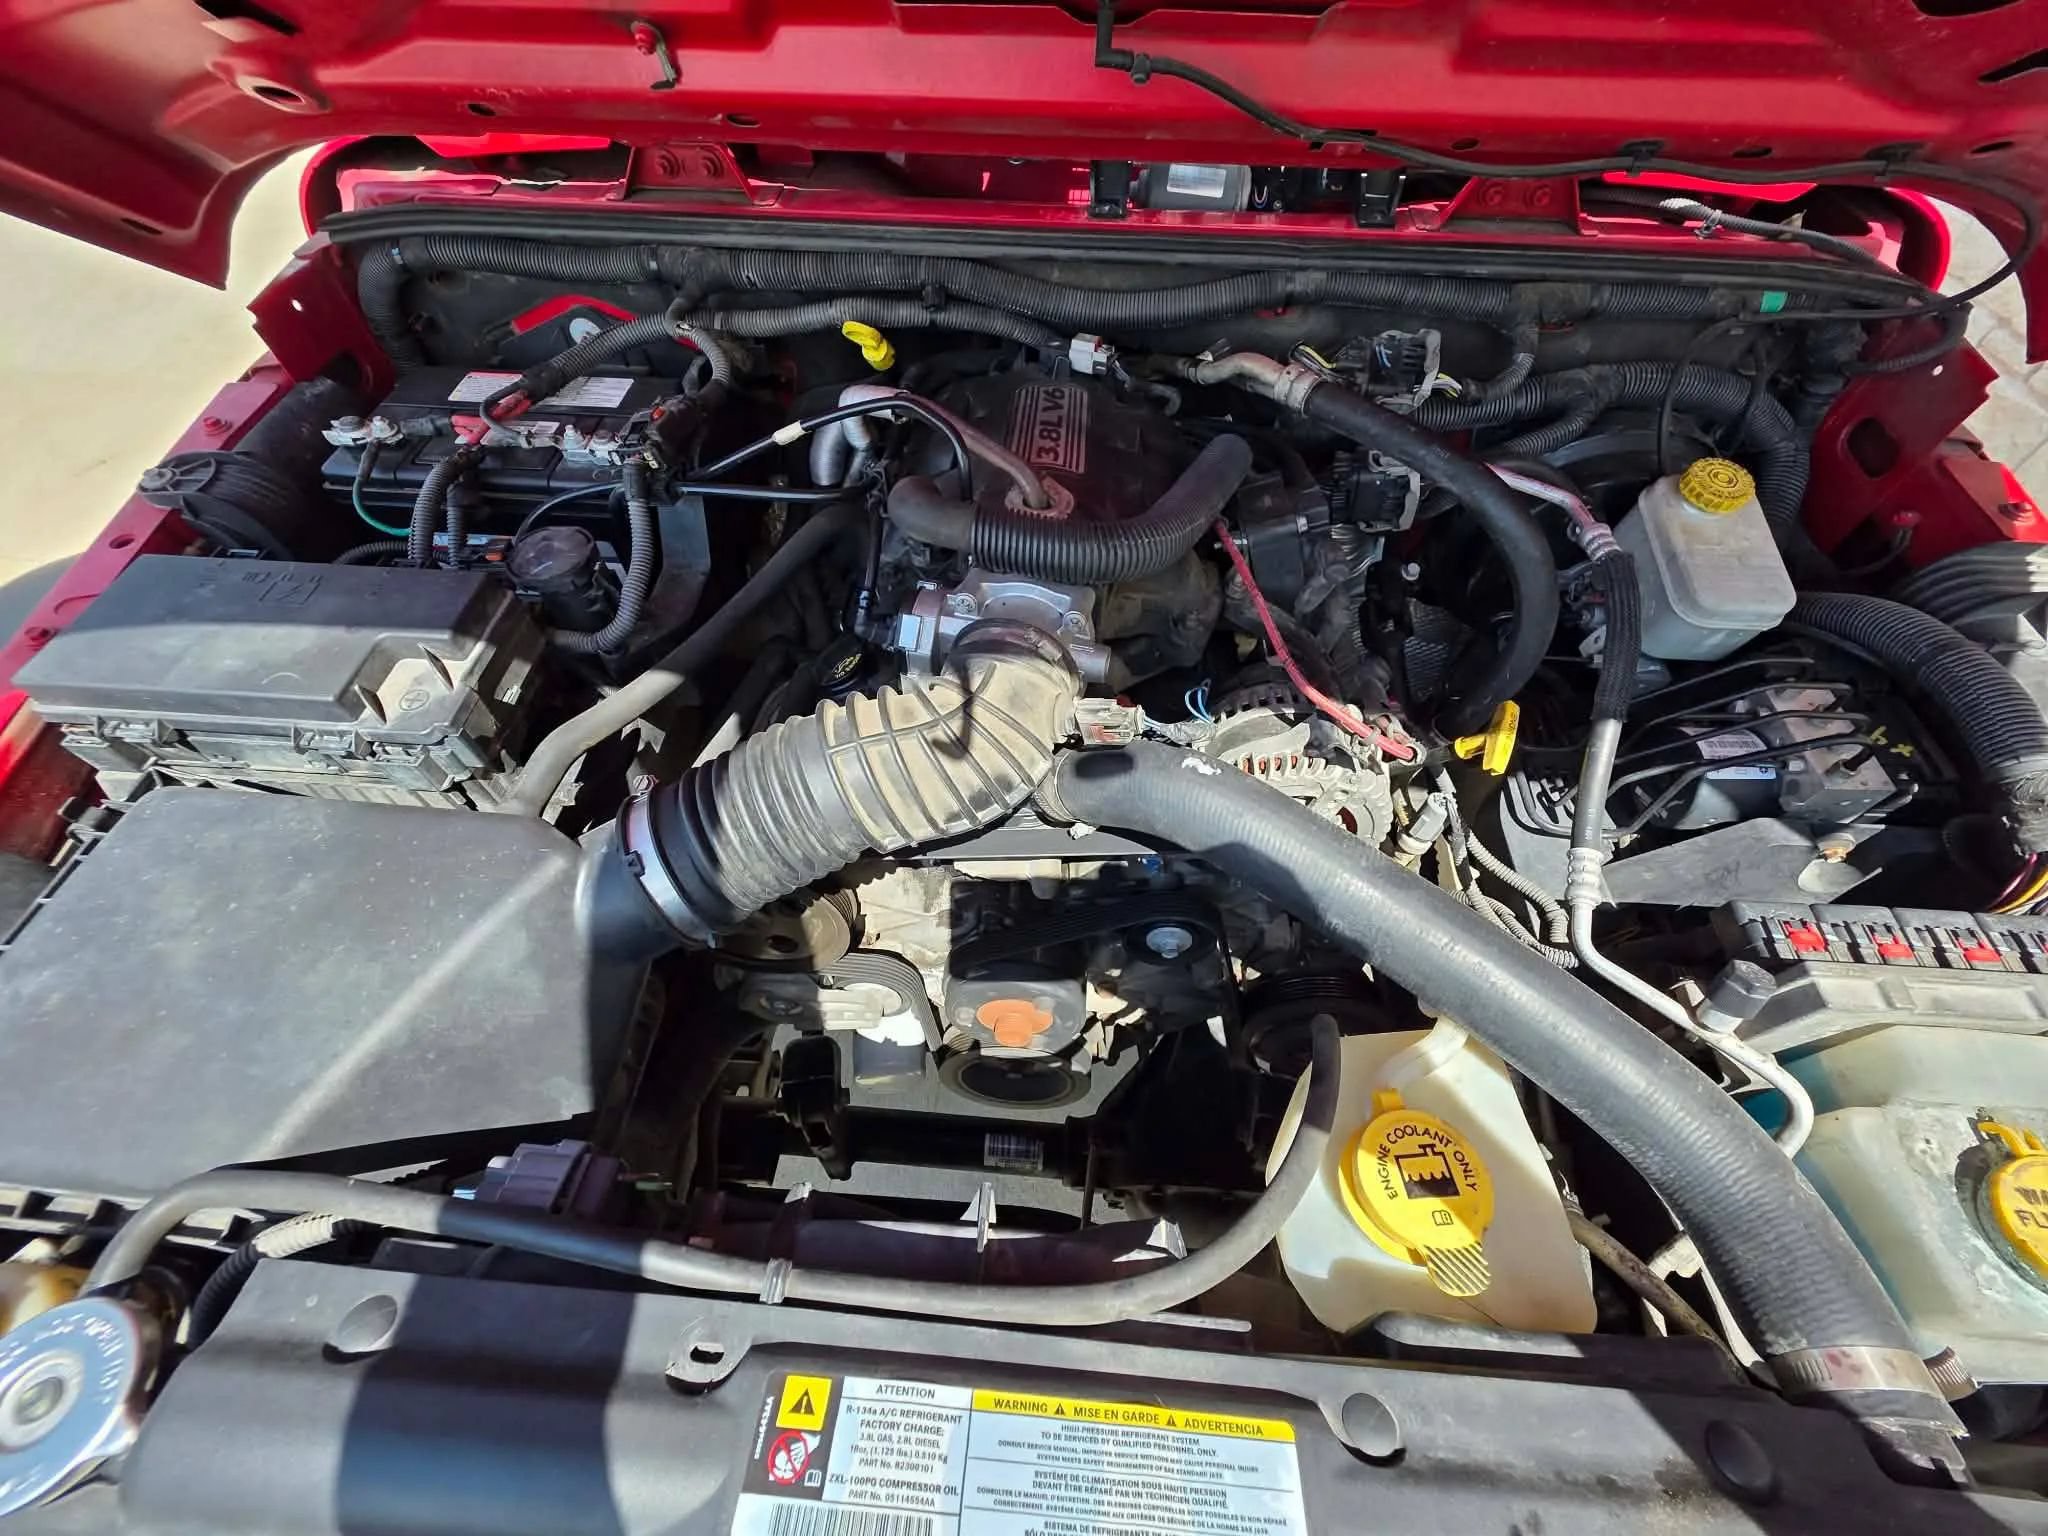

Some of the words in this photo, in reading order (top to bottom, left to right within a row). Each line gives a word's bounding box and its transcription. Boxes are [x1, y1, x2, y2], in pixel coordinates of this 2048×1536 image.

[1041, 387, 1065, 412] V6
[1037, 415, 1063, 461] 3.8L
[1386, 1125, 1452, 1148] COOLANT
[1377, 1143, 1398, 1200] ENGINE
[1453, 1150, 1478, 1192] ONLY
[876, 1384, 935, 1399] ATTENTION
[846, 1404, 877, 1415] R-134a
[879, 1407, 897, 1418] A/C
[899, 1409, 963, 1424] REFRIGERANT
[994, 1398, 1048, 1413] WARNING
[1073, 1407, 1101, 1419] MISE
[1104, 1409, 1119, 1420] EN
[1122, 1410, 1160, 1424] GARDE
[1184, 1418, 1264, 1436] ADVERTENCIA
[860, 1420, 901, 1431] FACTORY
[903, 1423, 945, 1437] CHARGE:
[914, 1438, 940, 1449] DIESEL
[1041, 1431, 1052, 1440] TO
[1064, 1434, 1100, 1444] SERVICED
[1112, 1438, 1151, 1449] QUALIFIED
[1153, 1443, 1195, 1455] PERSONNEL
[1172, 1435, 1200, 1446] SYSTEM
[858, 1458, 879, 1469] PART
[848, 1489, 868, 1500] PART
[879, 1479, 942, 1494] COMPRESSOR
[943, 1485, 959, 1497] OIL
[1032, 1480, 1062, 1491] DEVANT
[1115, 1489, 1130, 1498] PAR
[1131, 1491, 1143, 1500] UN
[1144, 1491, 1190, 1505] TECHNICIEN
[1070, 1473, 1081, 1482] DE
[1082, 1474, 1139, 1488] CLIMATISATION
[1141, 1480, 1163, 1490] SOUS
[1189, 1487, 1227, 1498] PRESSION
[1044, 1520, 1077, 1532] SISTEMA
[1079, 1524, 1090, 1534] DE
